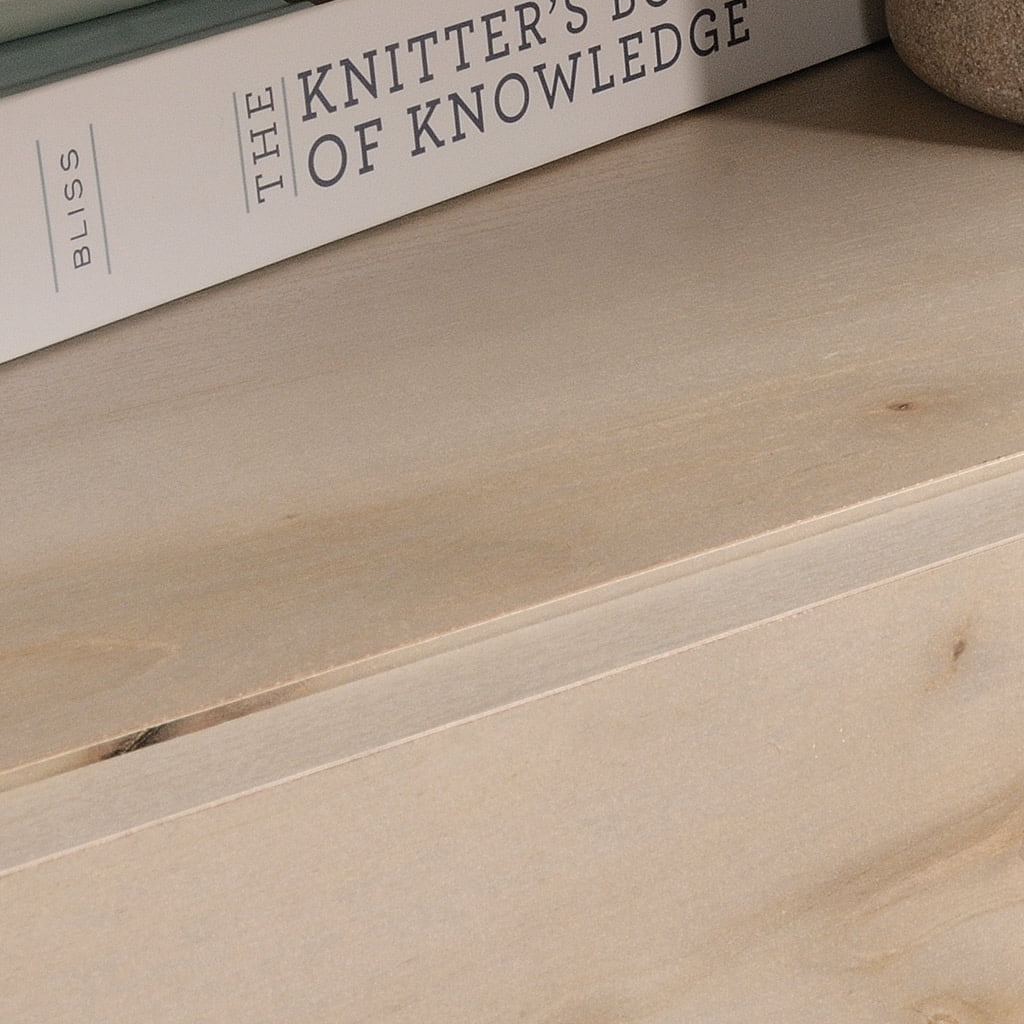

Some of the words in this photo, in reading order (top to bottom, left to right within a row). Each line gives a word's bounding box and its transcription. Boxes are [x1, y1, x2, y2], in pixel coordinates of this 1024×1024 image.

[245, 86, 284, 204] THE
[308, 117, 383, 187] OF
[60, 148, 92, 269] BLISS
